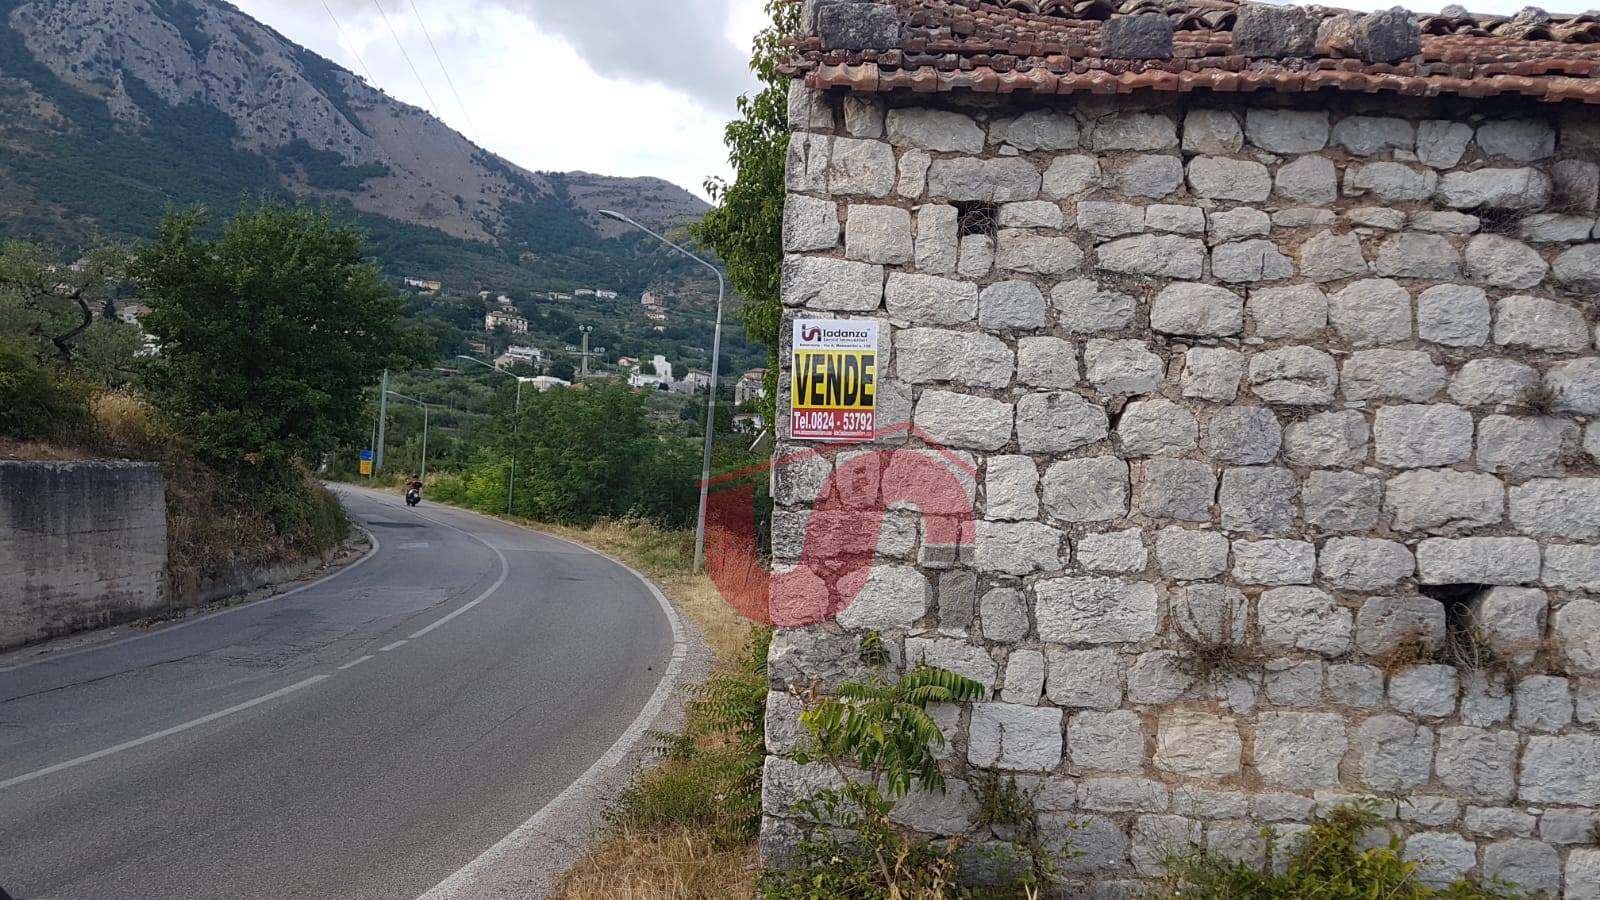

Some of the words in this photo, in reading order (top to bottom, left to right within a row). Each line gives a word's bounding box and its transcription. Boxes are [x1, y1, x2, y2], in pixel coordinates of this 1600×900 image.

[794, 353, 875, 406] VENDE
[793, 411, 835, 430] Tel.0824
[843, 412, 873, 431] 53792
